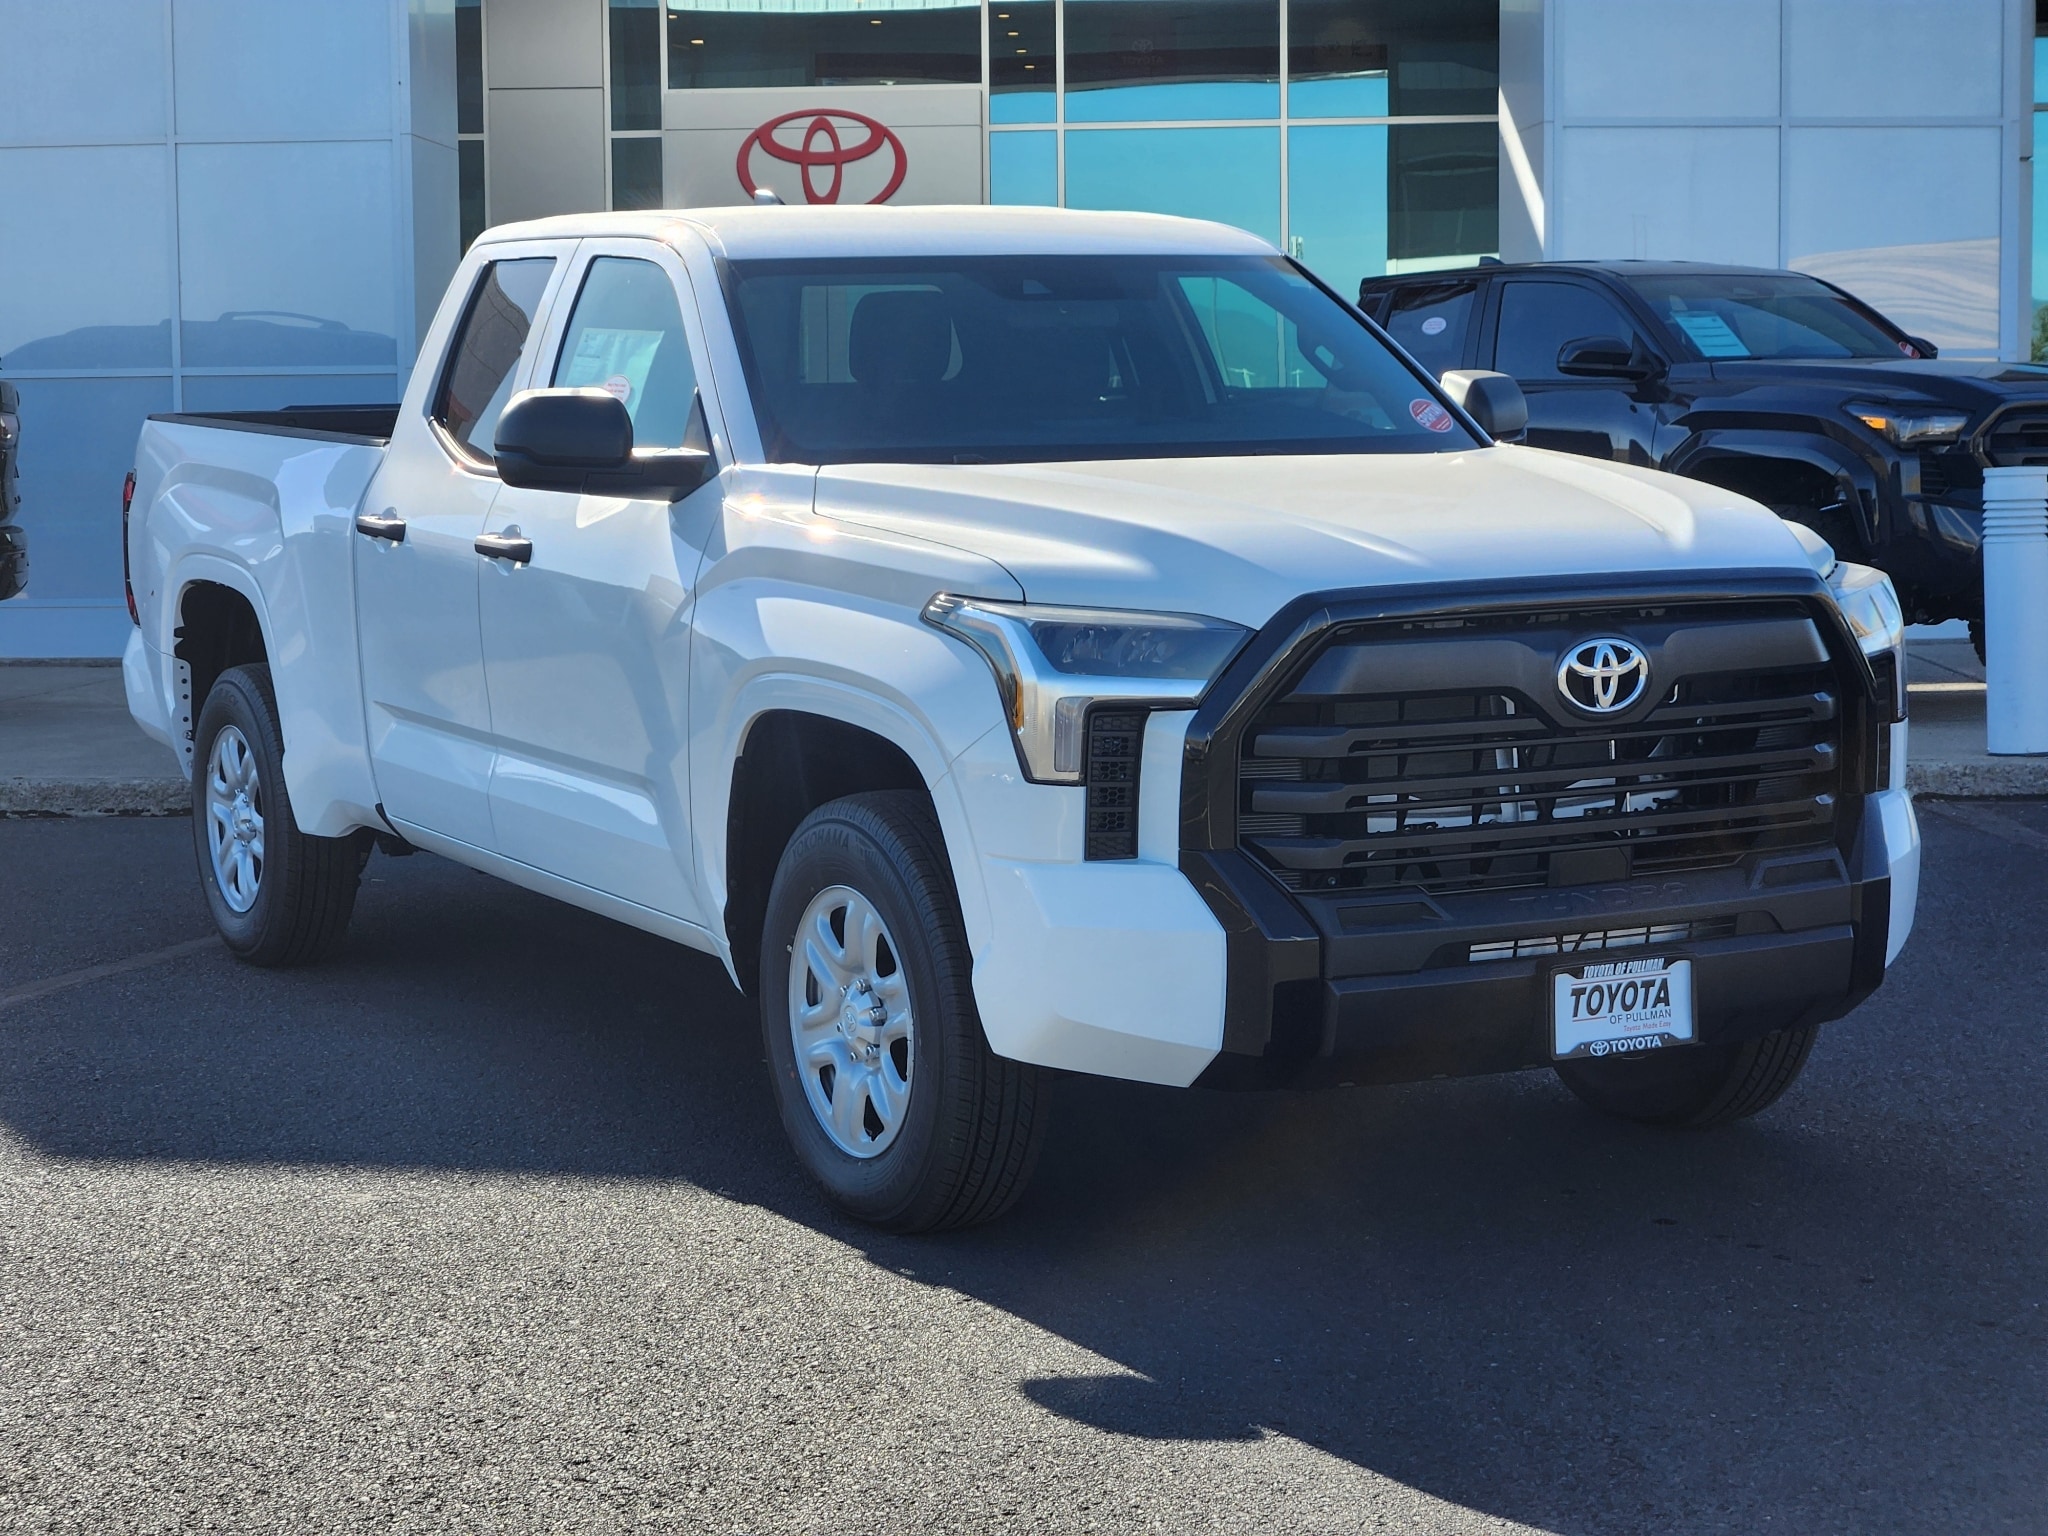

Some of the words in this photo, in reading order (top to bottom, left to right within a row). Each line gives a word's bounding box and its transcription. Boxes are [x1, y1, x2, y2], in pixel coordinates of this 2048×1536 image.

[791, 828, 849, 857] YOKOHAMA
[1583, 963, 1614, 978] TOYOTA
[1614, 961, 1626, 975] OF
[1626, 957, 1665, 974] PULLMAN
[1570, 978, 1670, 1018] TOYOTA
[1609, 1014, 1623, 1025] OF
[1625, 1008, 1672, 1023] PULLMAN
[1623, 1024, 1641, 1032] Toyota
[1610, 1035, 1662, 1053] TOYOTA
